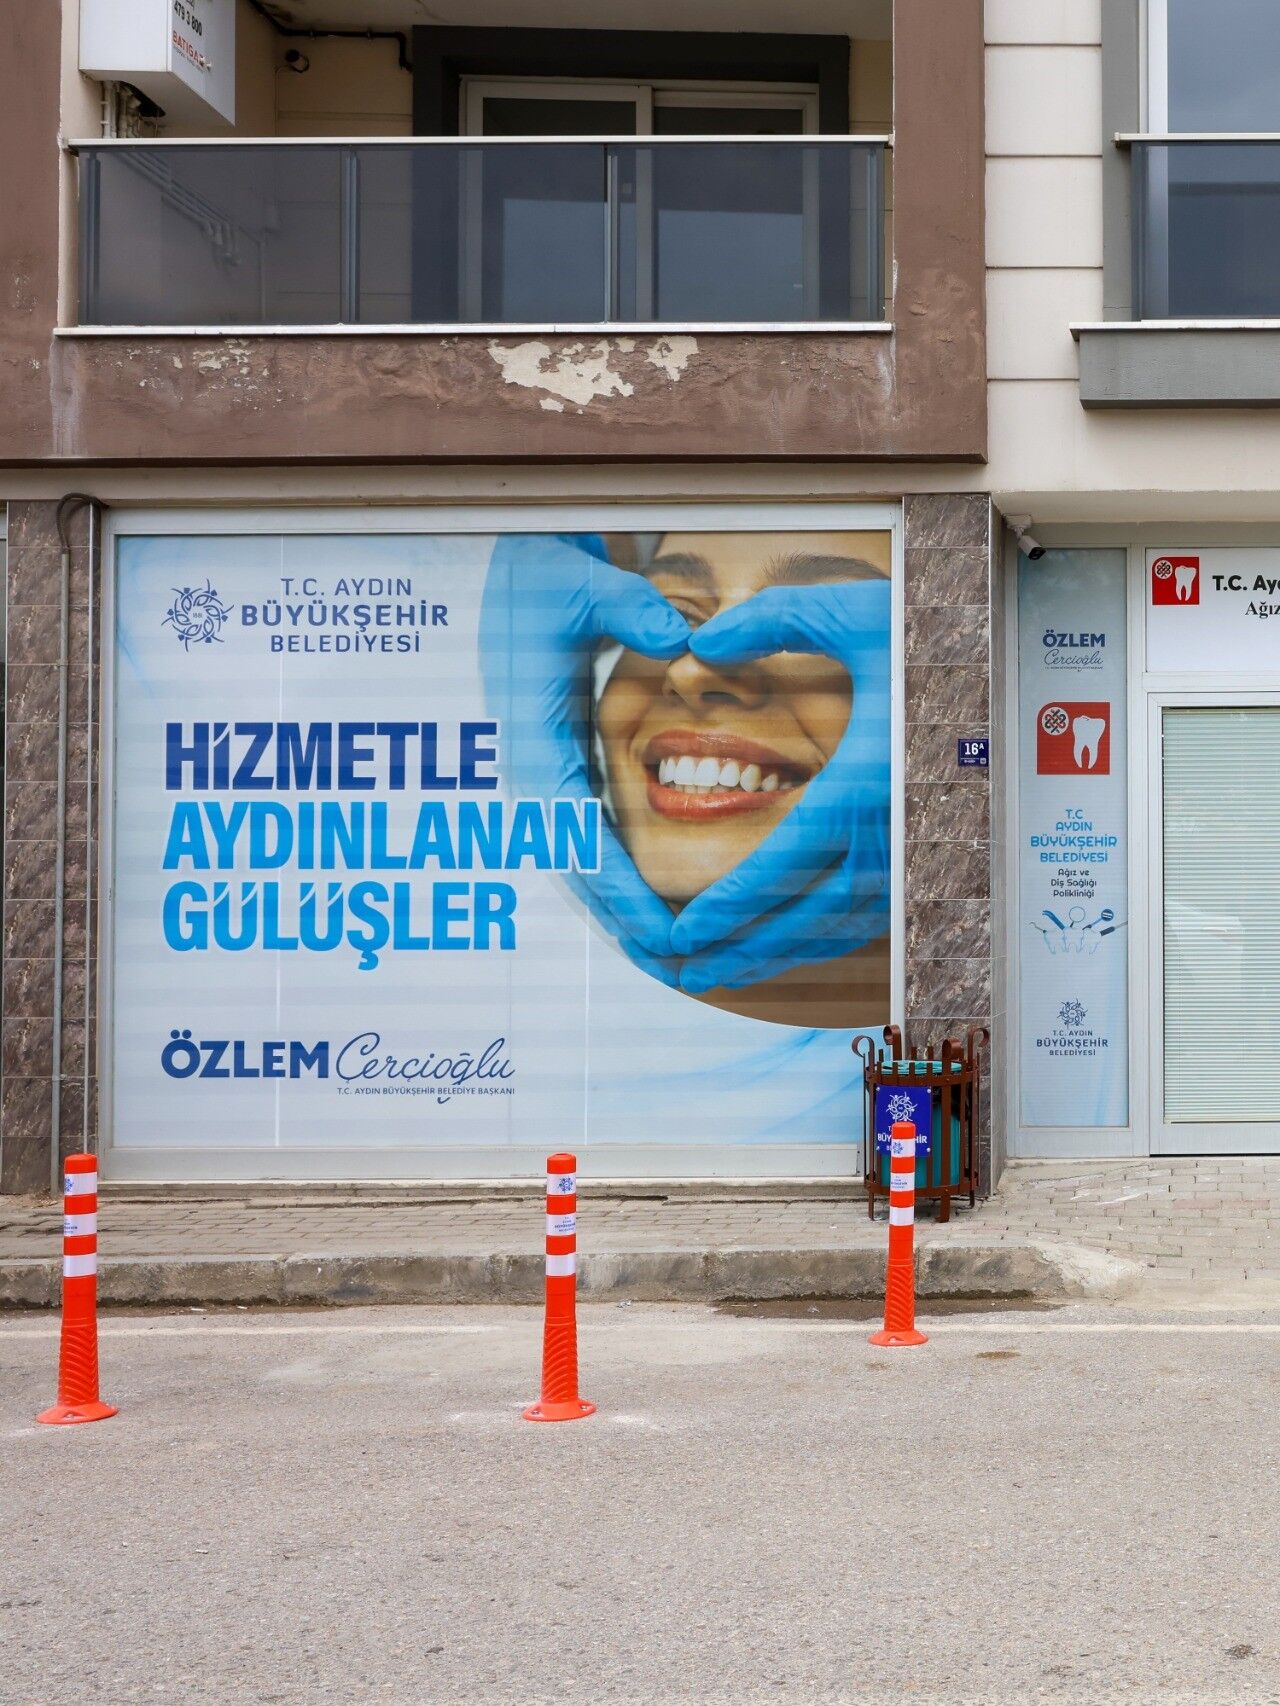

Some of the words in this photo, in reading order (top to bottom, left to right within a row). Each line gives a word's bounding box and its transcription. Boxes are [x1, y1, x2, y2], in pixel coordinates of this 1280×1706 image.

[280, 578, 325, 596] T.C.
[334, 578, 412, 596] AYDIN
[1211, 575, 1248, 592] T.C.
[241, 599, 449, 632] BÜYÜKŞEHİR
[270, 631, 421, 653] BELEDİYESİ
[1042, 628, 1106, 648] ÖZLEM
[164, 722, 499, 791] HİZMETLE
[1055, 821, 1093, 832] AYDIN
[162, 801, 599, 870] AYDINLANAN
[1030, 833, 1118, 850] BÜYÜKŞEHİR
[1040, 851, 1108, 862] BELEDİYESİ
[1057, 868, 1077, 877] Ağız
[1050, 878, 1065, 888] Diş
[1067, 878, 1097, 888] Sağlığı
[1053, 889, 1095, 899] Polikliniği
[162, 880, 518, 971] GÜLÜŞLER
[1036, 1037, 1109, 1049] BÜYÜKŞEHİR
[160, 1029, 329, 1079] ÖZLEM
[336, 1087, 352, 1095] T.C.
[354, 1087, 381, 1096] AYDIN
[382, 1085, 436, 1097] BÜYÜKŞEHİR
[437, 1086, 476, 1096] BELEDİYE
[477, 1087, 516, 1097] BAŞKANI
